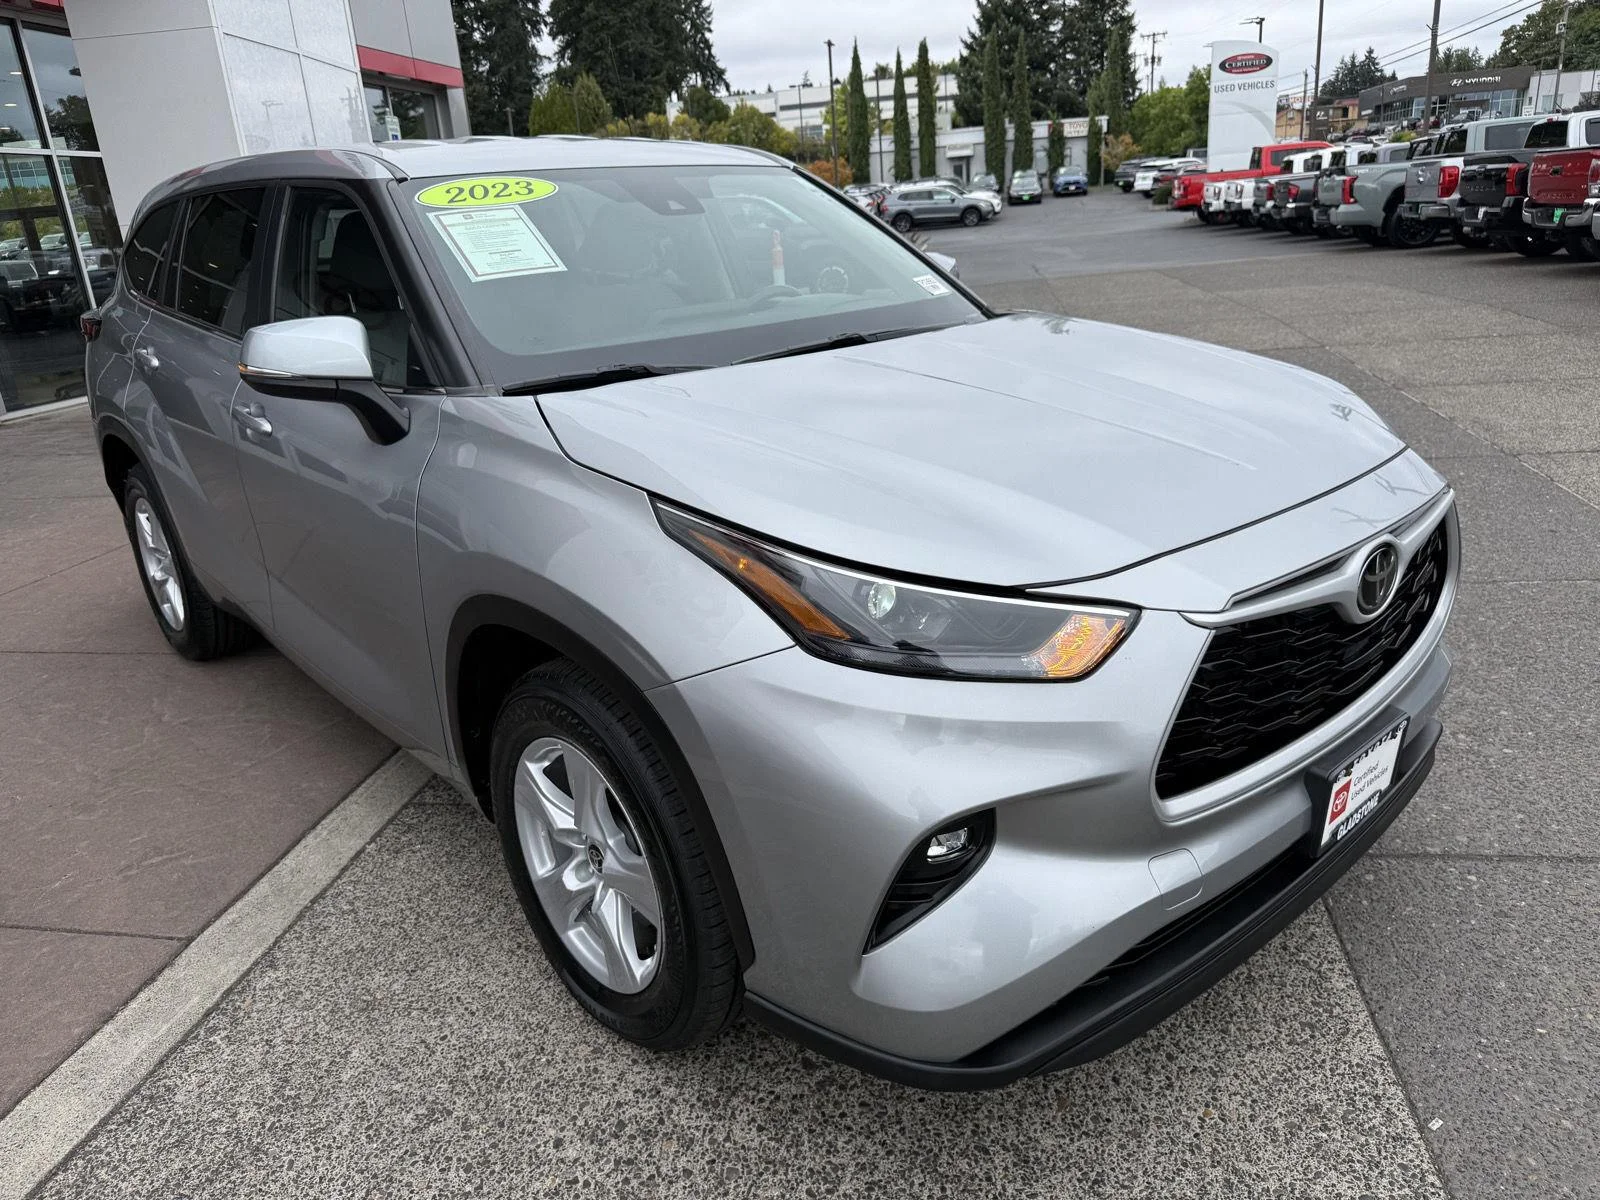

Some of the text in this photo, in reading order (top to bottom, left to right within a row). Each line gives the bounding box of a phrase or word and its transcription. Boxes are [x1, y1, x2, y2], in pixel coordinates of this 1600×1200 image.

[1225, 59, 1267, 69] CERTIFIED
[1214, 80, 1275, 93] USED VEHICLES
[1465, 76, 1501, 84] HYUNDAI
[445, 180, 535, 204] 2023
[1354, 760, 1380, 787] Certified
[1337, 791, 1380, 841] GLADSTONE
